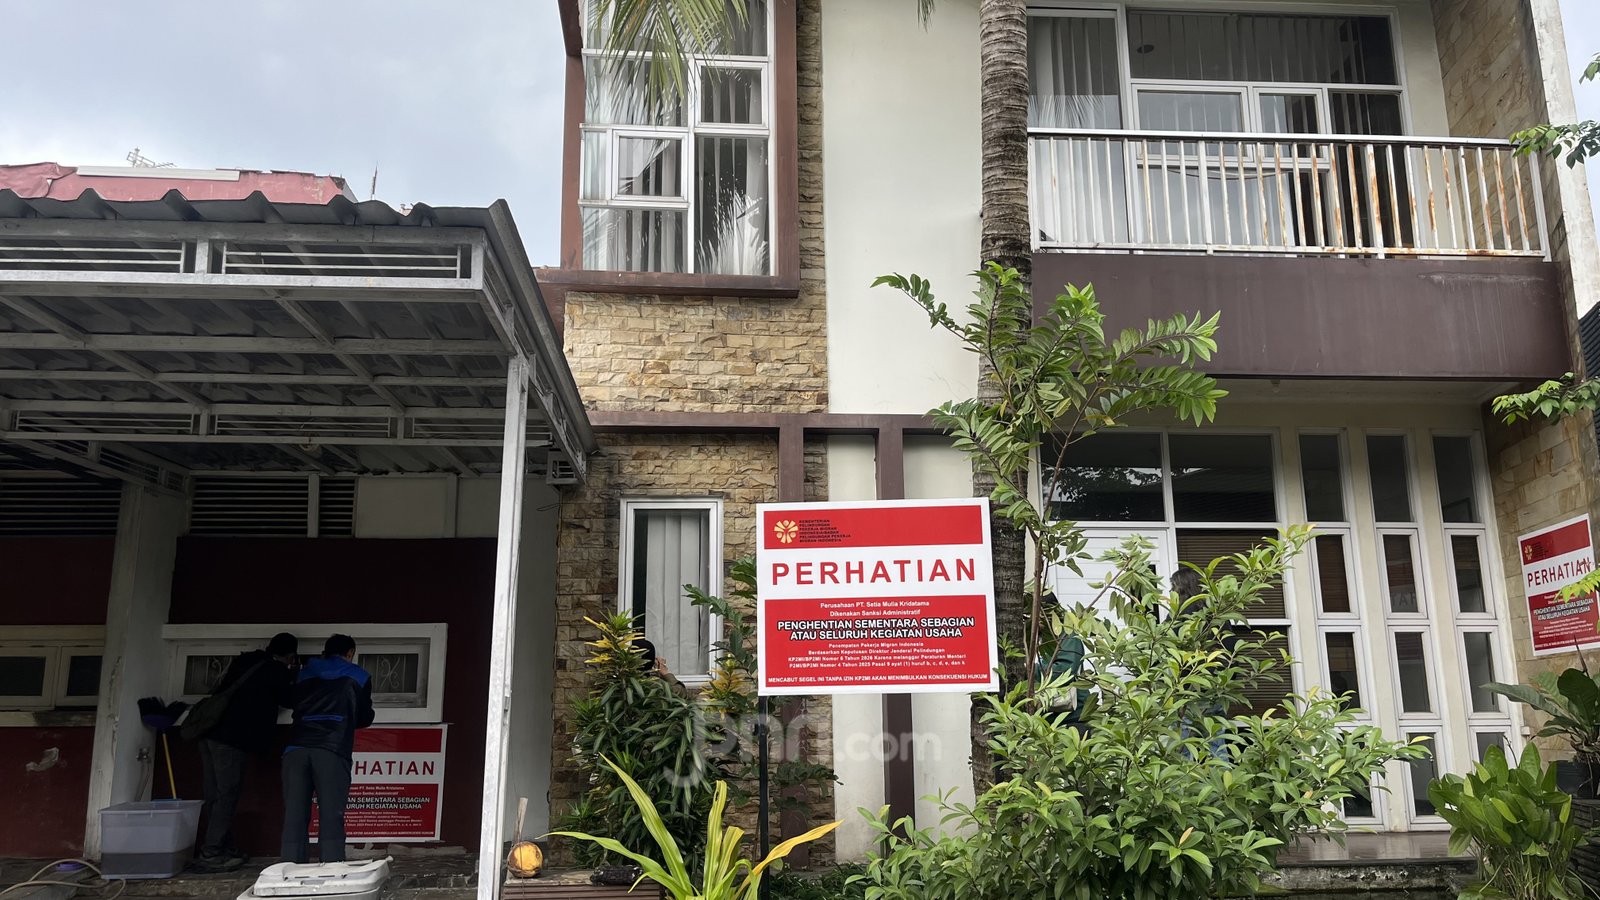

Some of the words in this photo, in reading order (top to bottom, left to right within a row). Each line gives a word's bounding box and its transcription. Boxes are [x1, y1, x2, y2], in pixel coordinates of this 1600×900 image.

[772, 558, 975, 586] PERHATIAN
[1527, 557, 1591, 588] PERHATIAN
[778, 620, 852, 630] PENGHENTIAN
[854, 618, 918, 629] SEMENTARA
[920, 617, 974, 627] SEBAGIAN
[790, 631, 817, 640] ATAU
[819, 630, 868, 639] SELURUH
[870, 628, 923, 638] KEGIATAN
[925, 628, 962, 637] USAHA
[354, 760, 435, 776] HATIAN
[357, 796, 397, 804] SEMENTARA
[397, 796, 431, 804] SEBAGIAN
